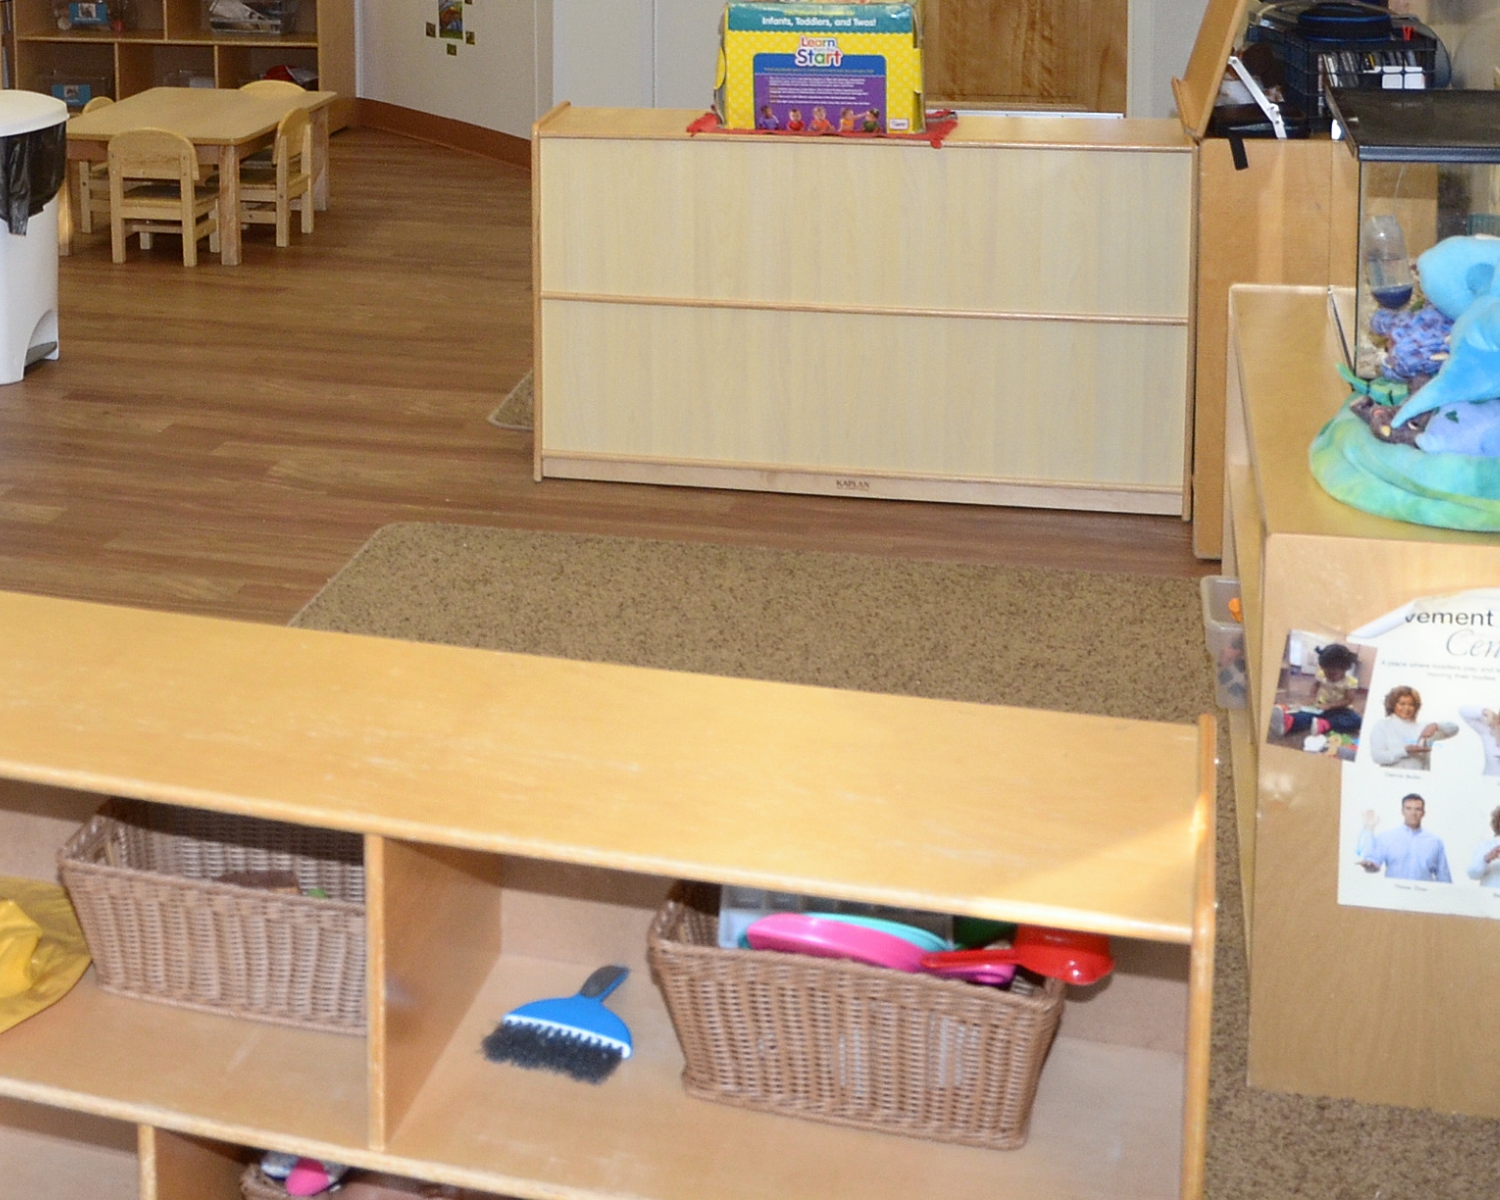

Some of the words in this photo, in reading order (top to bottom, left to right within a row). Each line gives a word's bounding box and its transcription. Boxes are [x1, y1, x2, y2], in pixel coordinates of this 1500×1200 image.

[762, 17, 793, 27] Infants,
[795, 17, 832, 27] Toddlers,
[834, 17, 851, 26] and
[853, 17, 877, 26] Twos!
[801, 37, 835, 47] Learn
[797, 48, 841, 65] Start
[1405, 610, 1493, 627] vement
